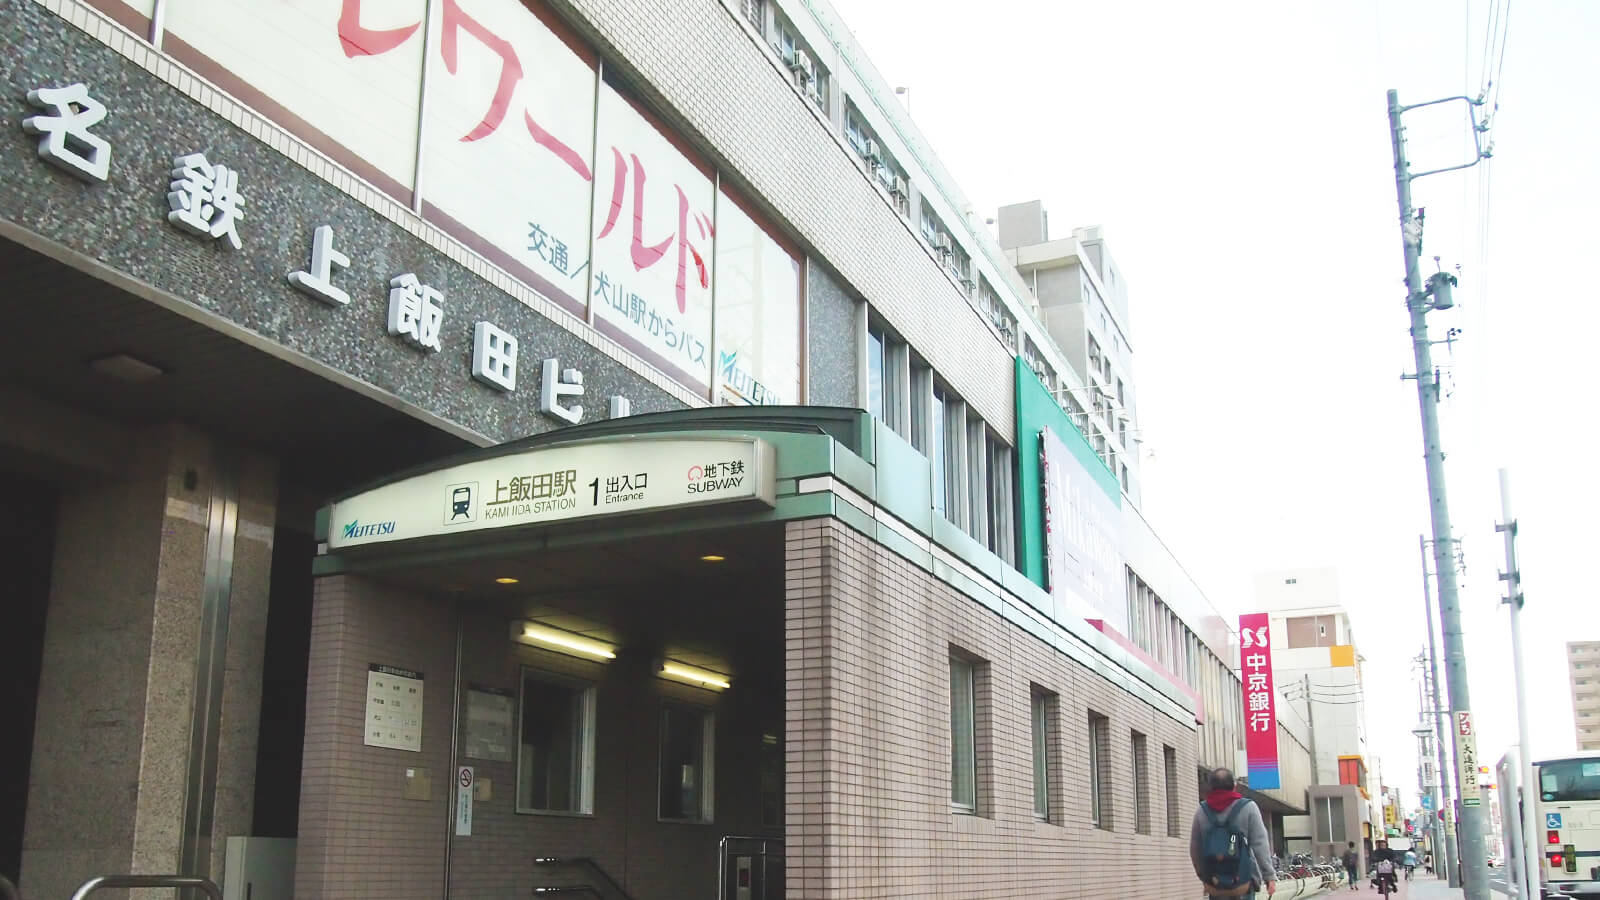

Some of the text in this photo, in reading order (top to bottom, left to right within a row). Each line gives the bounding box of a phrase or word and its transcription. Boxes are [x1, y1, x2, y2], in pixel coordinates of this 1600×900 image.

[23, 83, 631, 419] 名鉄上飯田ビ
[703, 459, 745, 479] 地下鉄
[486, 469, 648, 506] 上飯田駅 1 出入口
[687, 477, 744, 494] SUBWAY
[485, 507, 510, 520] KAMI
[533, 497, 576, 514] STATION
[605, 492, 644, 505] Entrance
[342, 520, 396, 539] MEITETSU
[1246, 653, 1270, 732] 中京銀行
